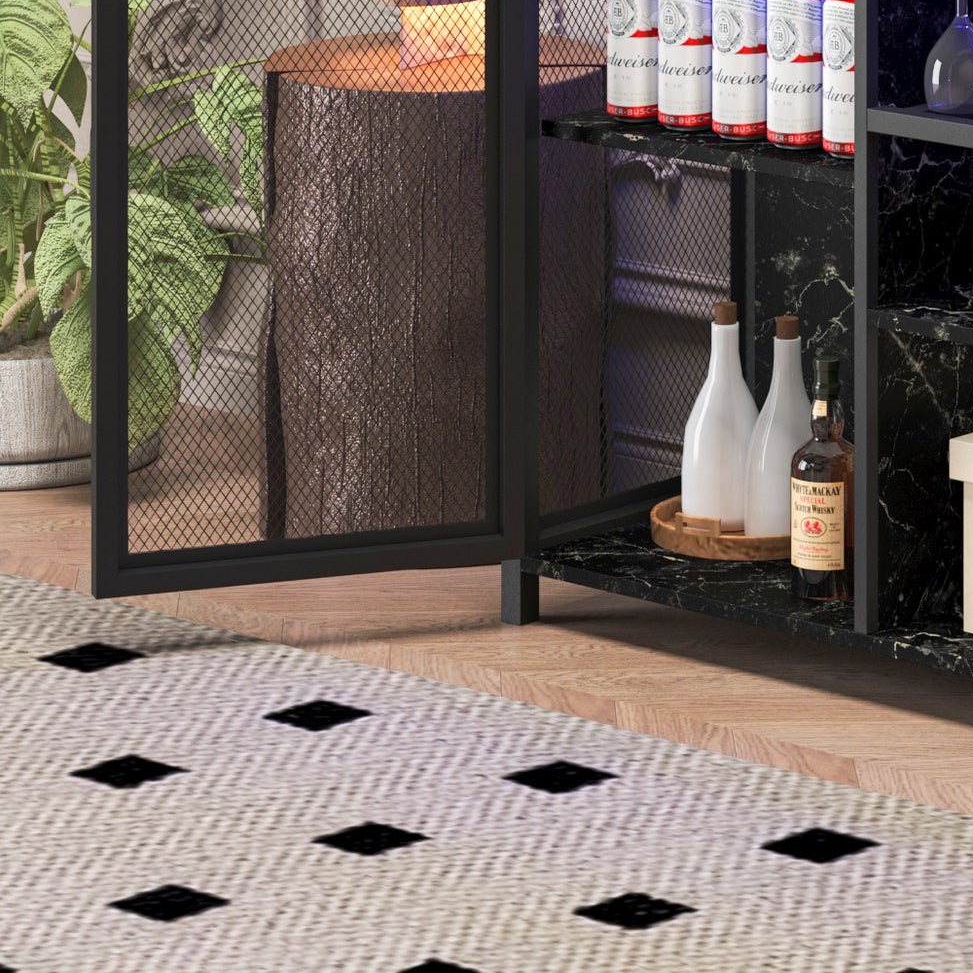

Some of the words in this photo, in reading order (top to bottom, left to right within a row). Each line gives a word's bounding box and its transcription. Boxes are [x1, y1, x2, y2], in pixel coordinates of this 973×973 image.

[609, 52, 658, 68] dweiser
[658, 60, 712, 76] dweiser
[713, 68, 767, 85] dweiser
[767, 76, 822, 93] dweiser
[812, 504, 836, 514] WHISKY
